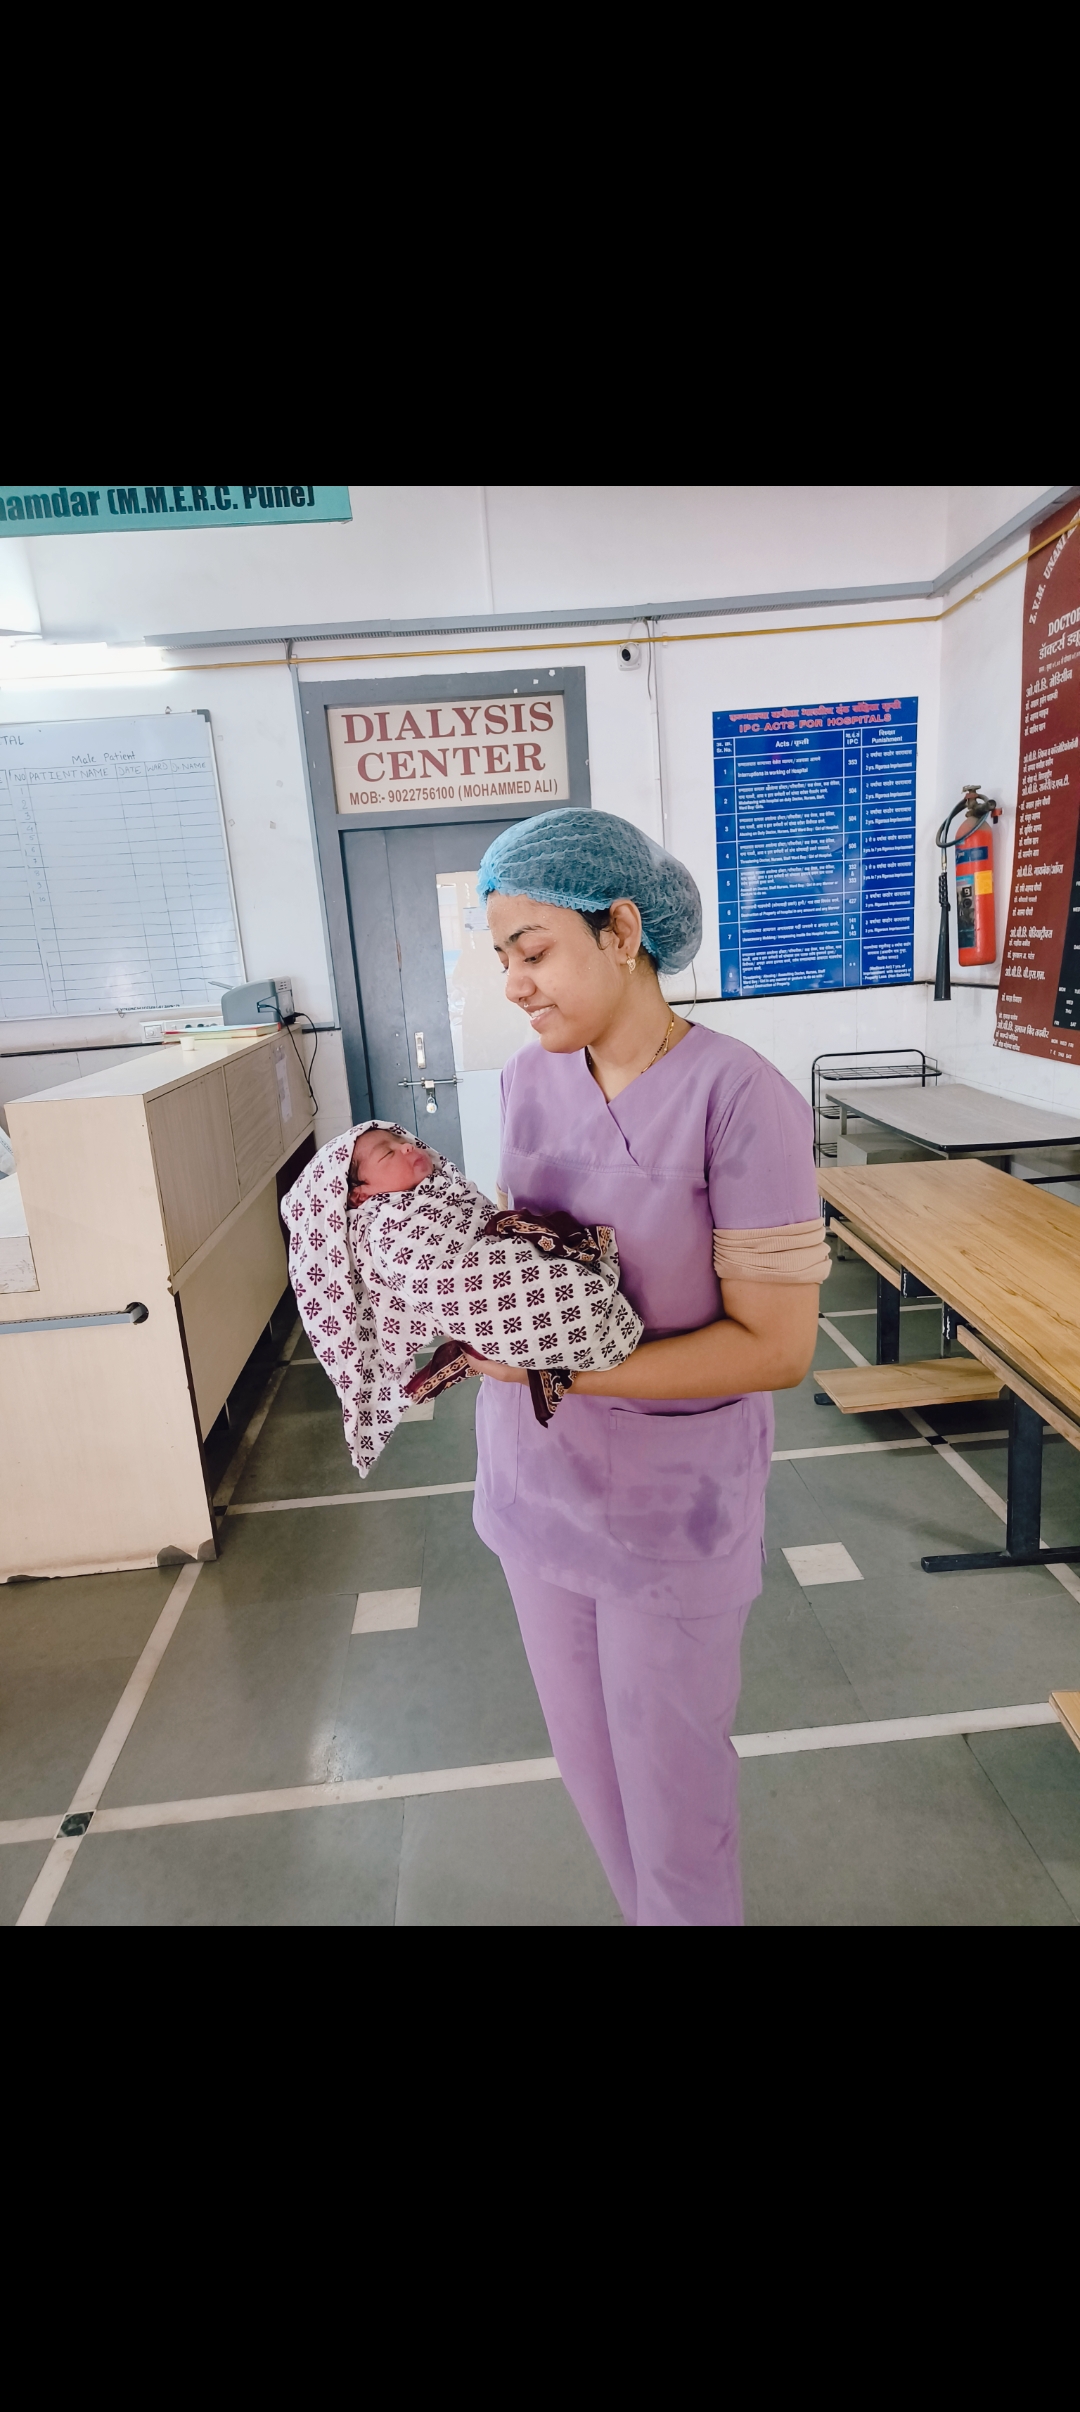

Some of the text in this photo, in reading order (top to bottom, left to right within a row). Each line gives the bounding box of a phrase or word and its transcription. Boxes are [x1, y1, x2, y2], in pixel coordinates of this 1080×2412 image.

[108, 486, 238, 515] (M.M.E.R.C.
[242, 486, 315, 509] Pune)
[1043, 533, 1067, 579] UNANI
[1039, 632, 1065, 660] डॉक्टर्स
[341, 701, 554, 744] DIALYSIS
[739, 714, 891, 733] IPC ACTS FOR HOSPITALS
[72, 751, 136, 764] Male Patient
[181, 762, 206, 770] NAME
[357, 742, 545, 782] CENTER
[118, 765, 141, 775] DATE
[147, 762, 168, 771] WARD
[29, 768, 109, 783] PATIENT NAME
[350, 792, 385, 805] MOB:-
[388, 786, 454, 803] 9022756100
[458, 780, 531, 801] (MOHAMMED
[21, 800, 28, 810] 2
[24, 811, 32, 821] 3
